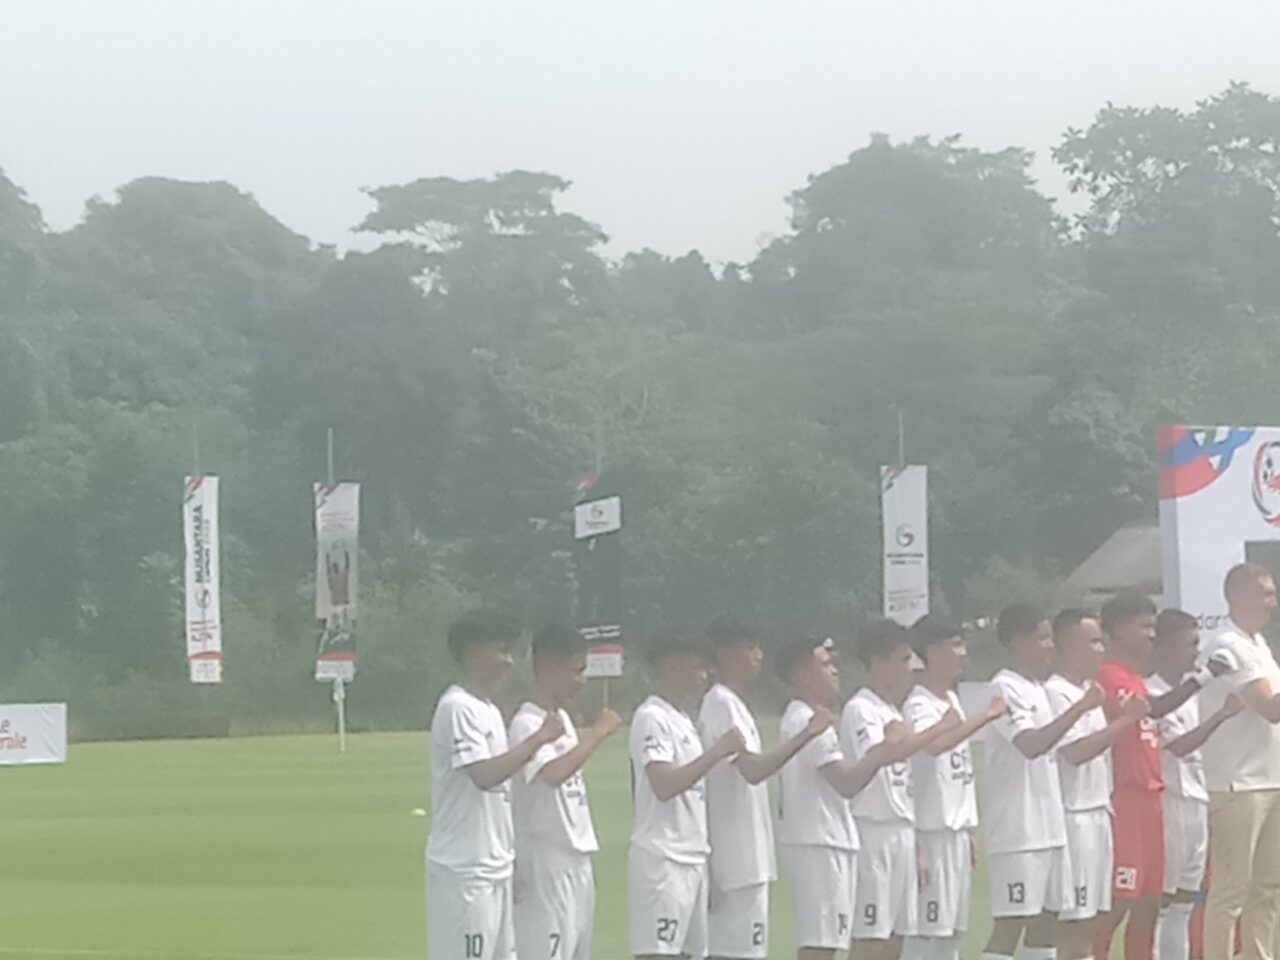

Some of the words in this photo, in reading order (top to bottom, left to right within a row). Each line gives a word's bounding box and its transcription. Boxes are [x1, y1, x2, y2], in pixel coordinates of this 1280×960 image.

[1006, 881, 1026, 904] 13
[864, 903, 878, 927] 9
[925, 900, 939, 923] 8
[656, 918, 678, 942] 27
[753, 922, 765, 946] 2
[464, 932, 484, 958] 10
[549, 933, 561, 958] 7
